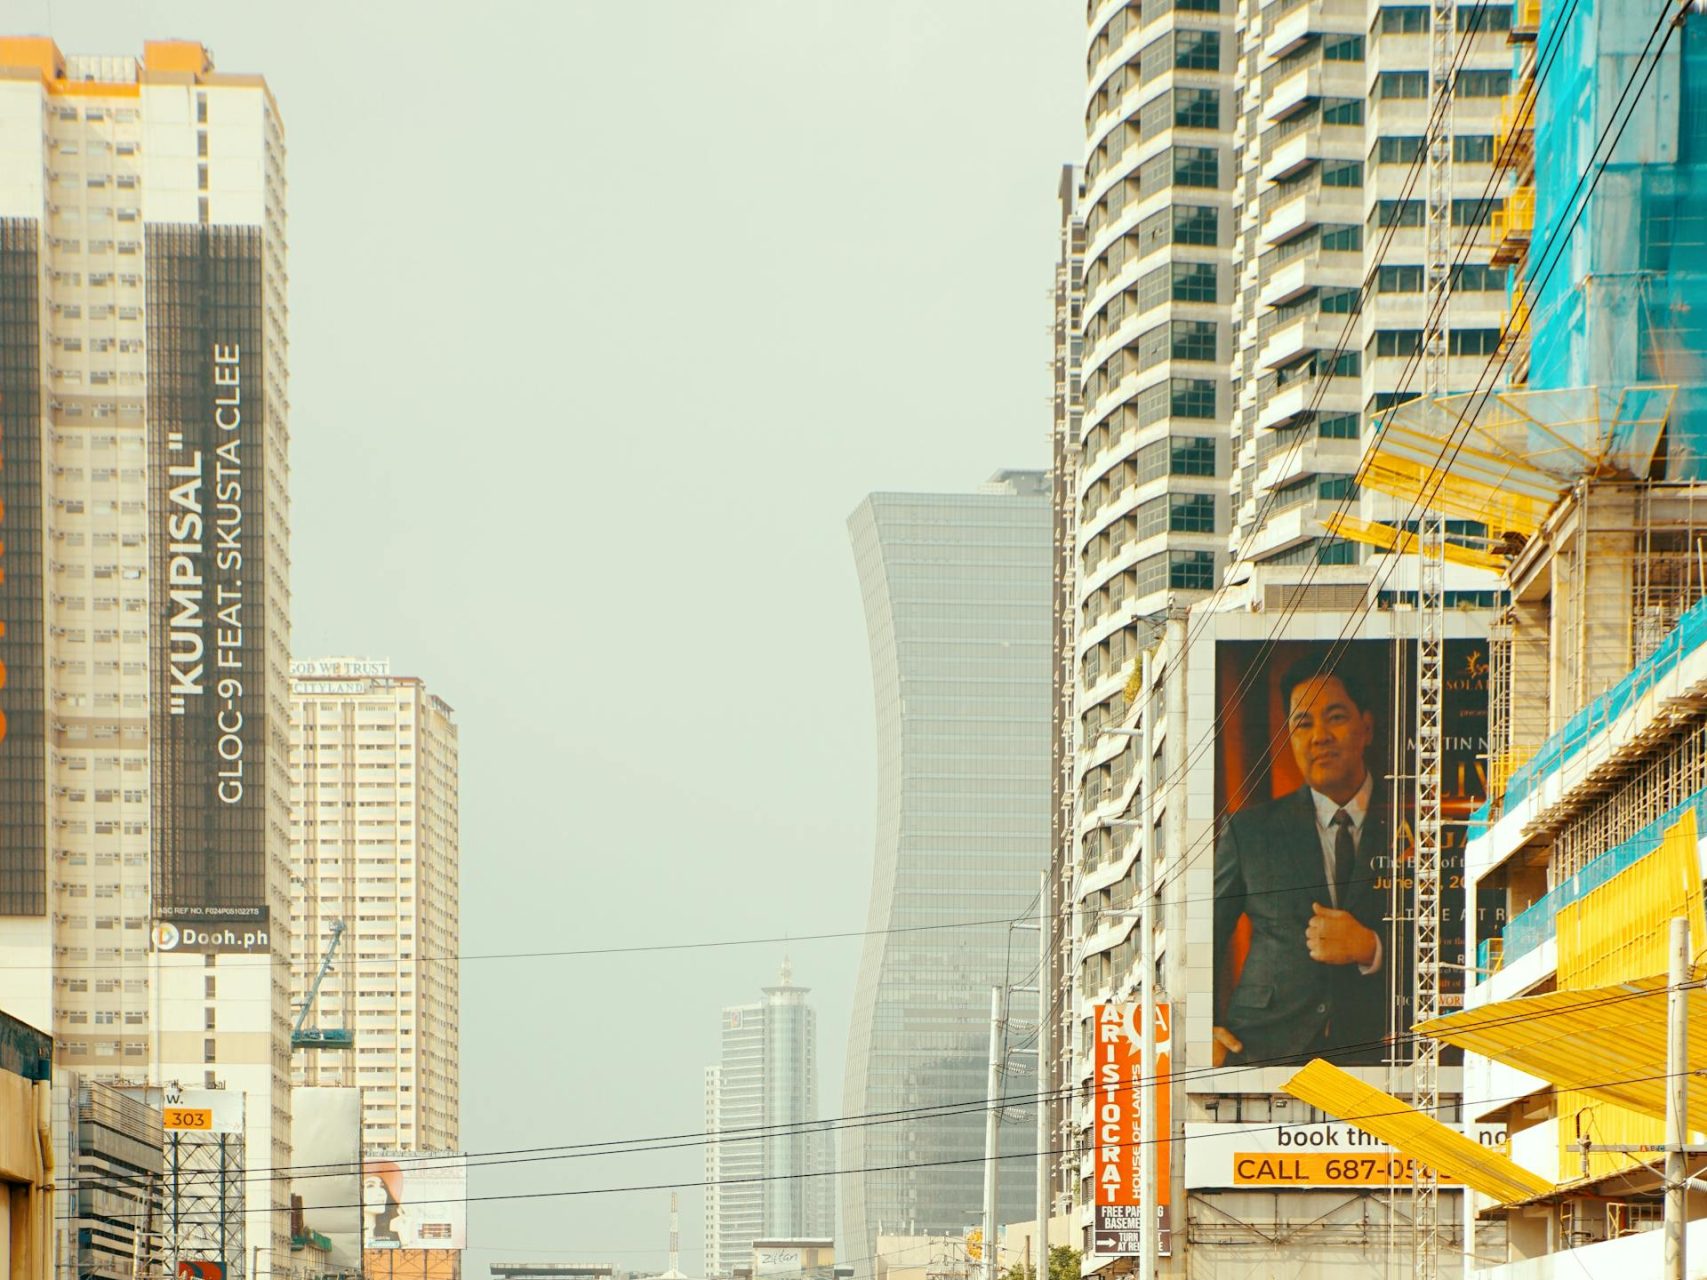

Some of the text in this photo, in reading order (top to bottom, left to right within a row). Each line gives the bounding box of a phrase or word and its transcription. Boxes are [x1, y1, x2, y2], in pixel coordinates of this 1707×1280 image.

[168, 433, 204, 714] "KUMPISAL"
[215, 344, 243, 804] GLOC-9 FEAT. SKUSTA CLEE
[344, 663, 388, 674] TRUST
[294, 683, 363, 693] CITYLAND
[182, 929, 268, 948] Dooh.ph
[1100, 1004, 1121, 1203] ARISTOCRAT
[1131, 1064, 1142, 1199] HOUSE OF LAMPS
[1278, 1126, 1339, 1146] book
[1237, 1159, 1310, 1180] CALL
[1101, 1206, 1124, 1218] FREE
[1104, 1218, 1146, 1229] BASEME
